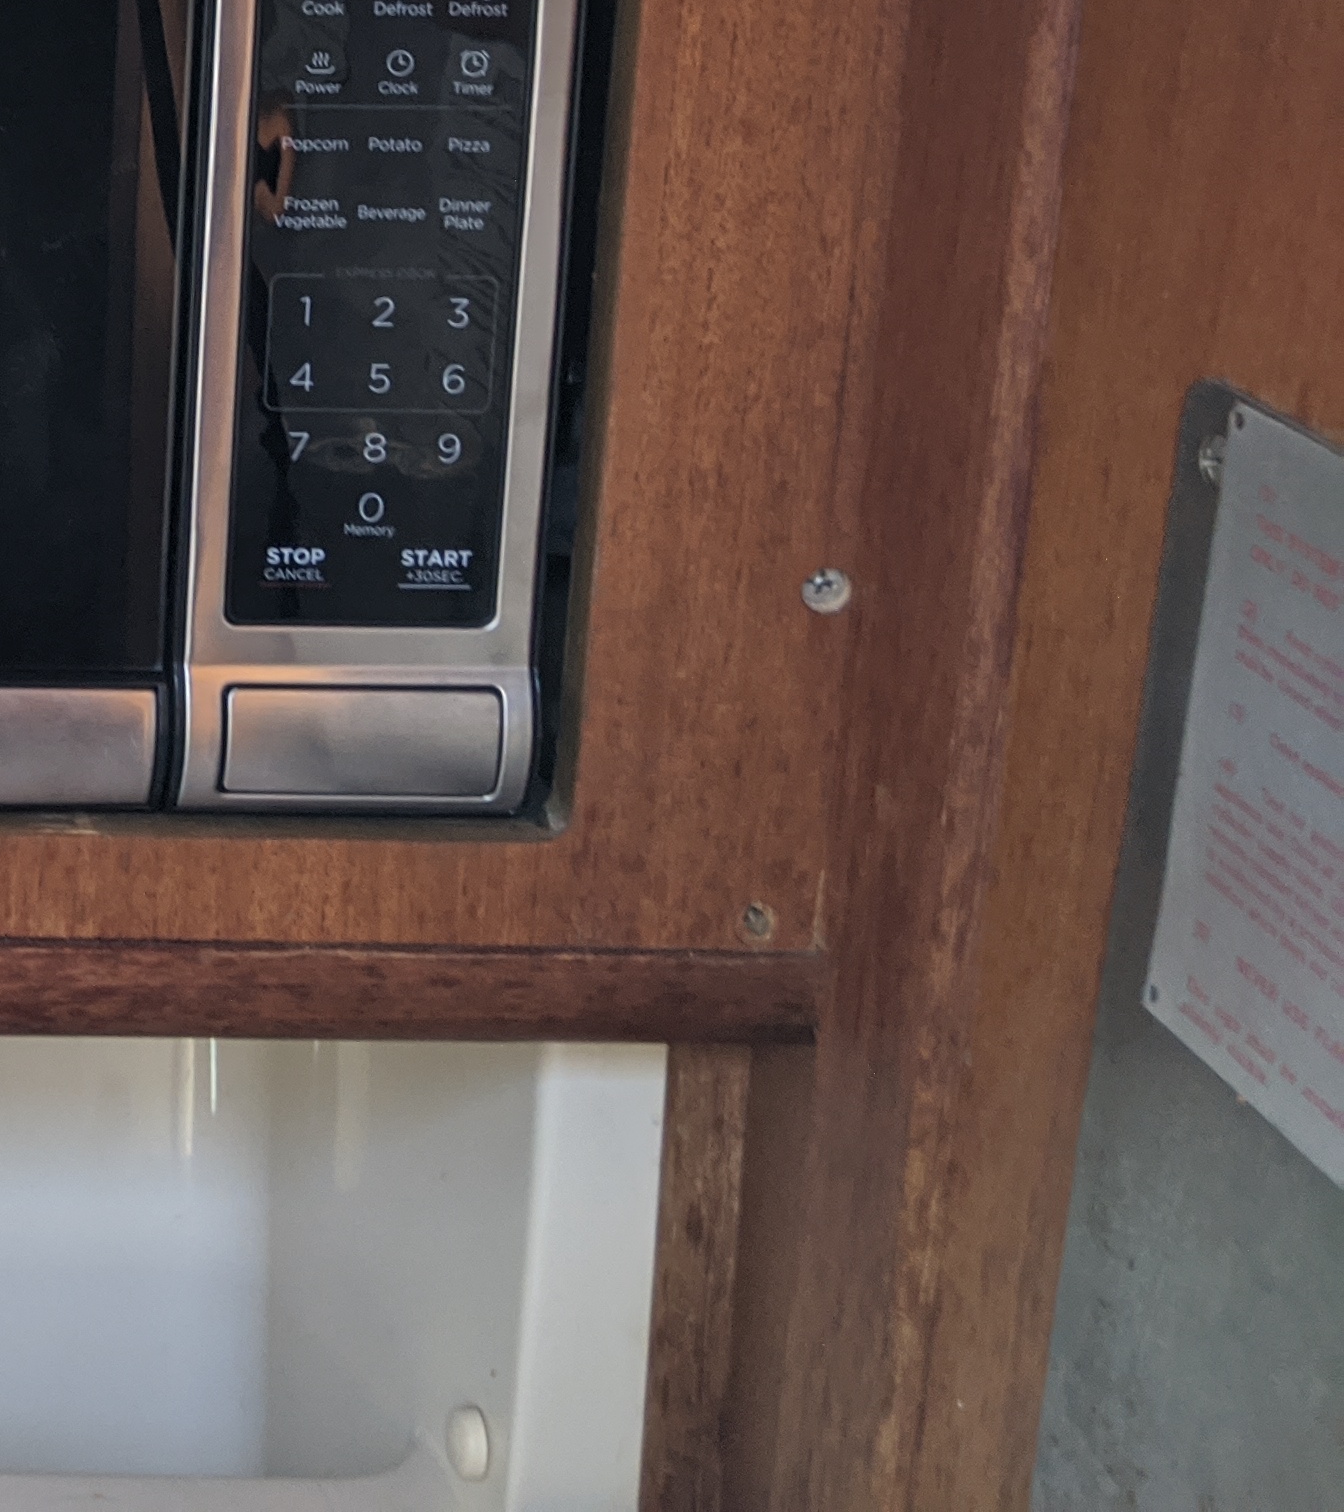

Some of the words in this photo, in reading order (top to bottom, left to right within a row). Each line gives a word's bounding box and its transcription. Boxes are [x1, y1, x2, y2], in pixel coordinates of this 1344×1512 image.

[302, 0, 345, 16] Cook
[373, 1, 433, 17] Defrost
[448, 1, 508, 17] Defrost
[295, 79, 342, 94] Power
[377, 80, 419, 95] Clock
[453, 81, 494, 95] Timer
[281, 136, 349, 153] Popcorn
[368, 136, 423, 153] Potato
[448, 137, 491, 153] Pizza
[283, 196, 340, 211] Frozen
[439, 198, 492, 213] Dinner
[357, 204, 426, 222] Beverage
[274, 214, 348, 231] Vegetable
[443, 215, 484, 230] Plate
[300, 295, 312, 327] 1
[371, 296, 395, 328] 2
[447, 297, 470, 329] 3
[289, 362, 314, 392] 4
[368, 363, 391, 394] 5
[442, 364, 465, 395] 6
[288, 431, 310, 463] 7
[363, 432, 387, 464] 8
[438, 433, 461, 464] 9
[358, 492, 385, 523] 0
[343, 523, 396, 538] Memory
[266, 547, 326, 565] STOP
[400, 548, 473, 567] START
[263, 567, 325, 581] CANCEL
[406, 569, 463, 584] +30SEC
